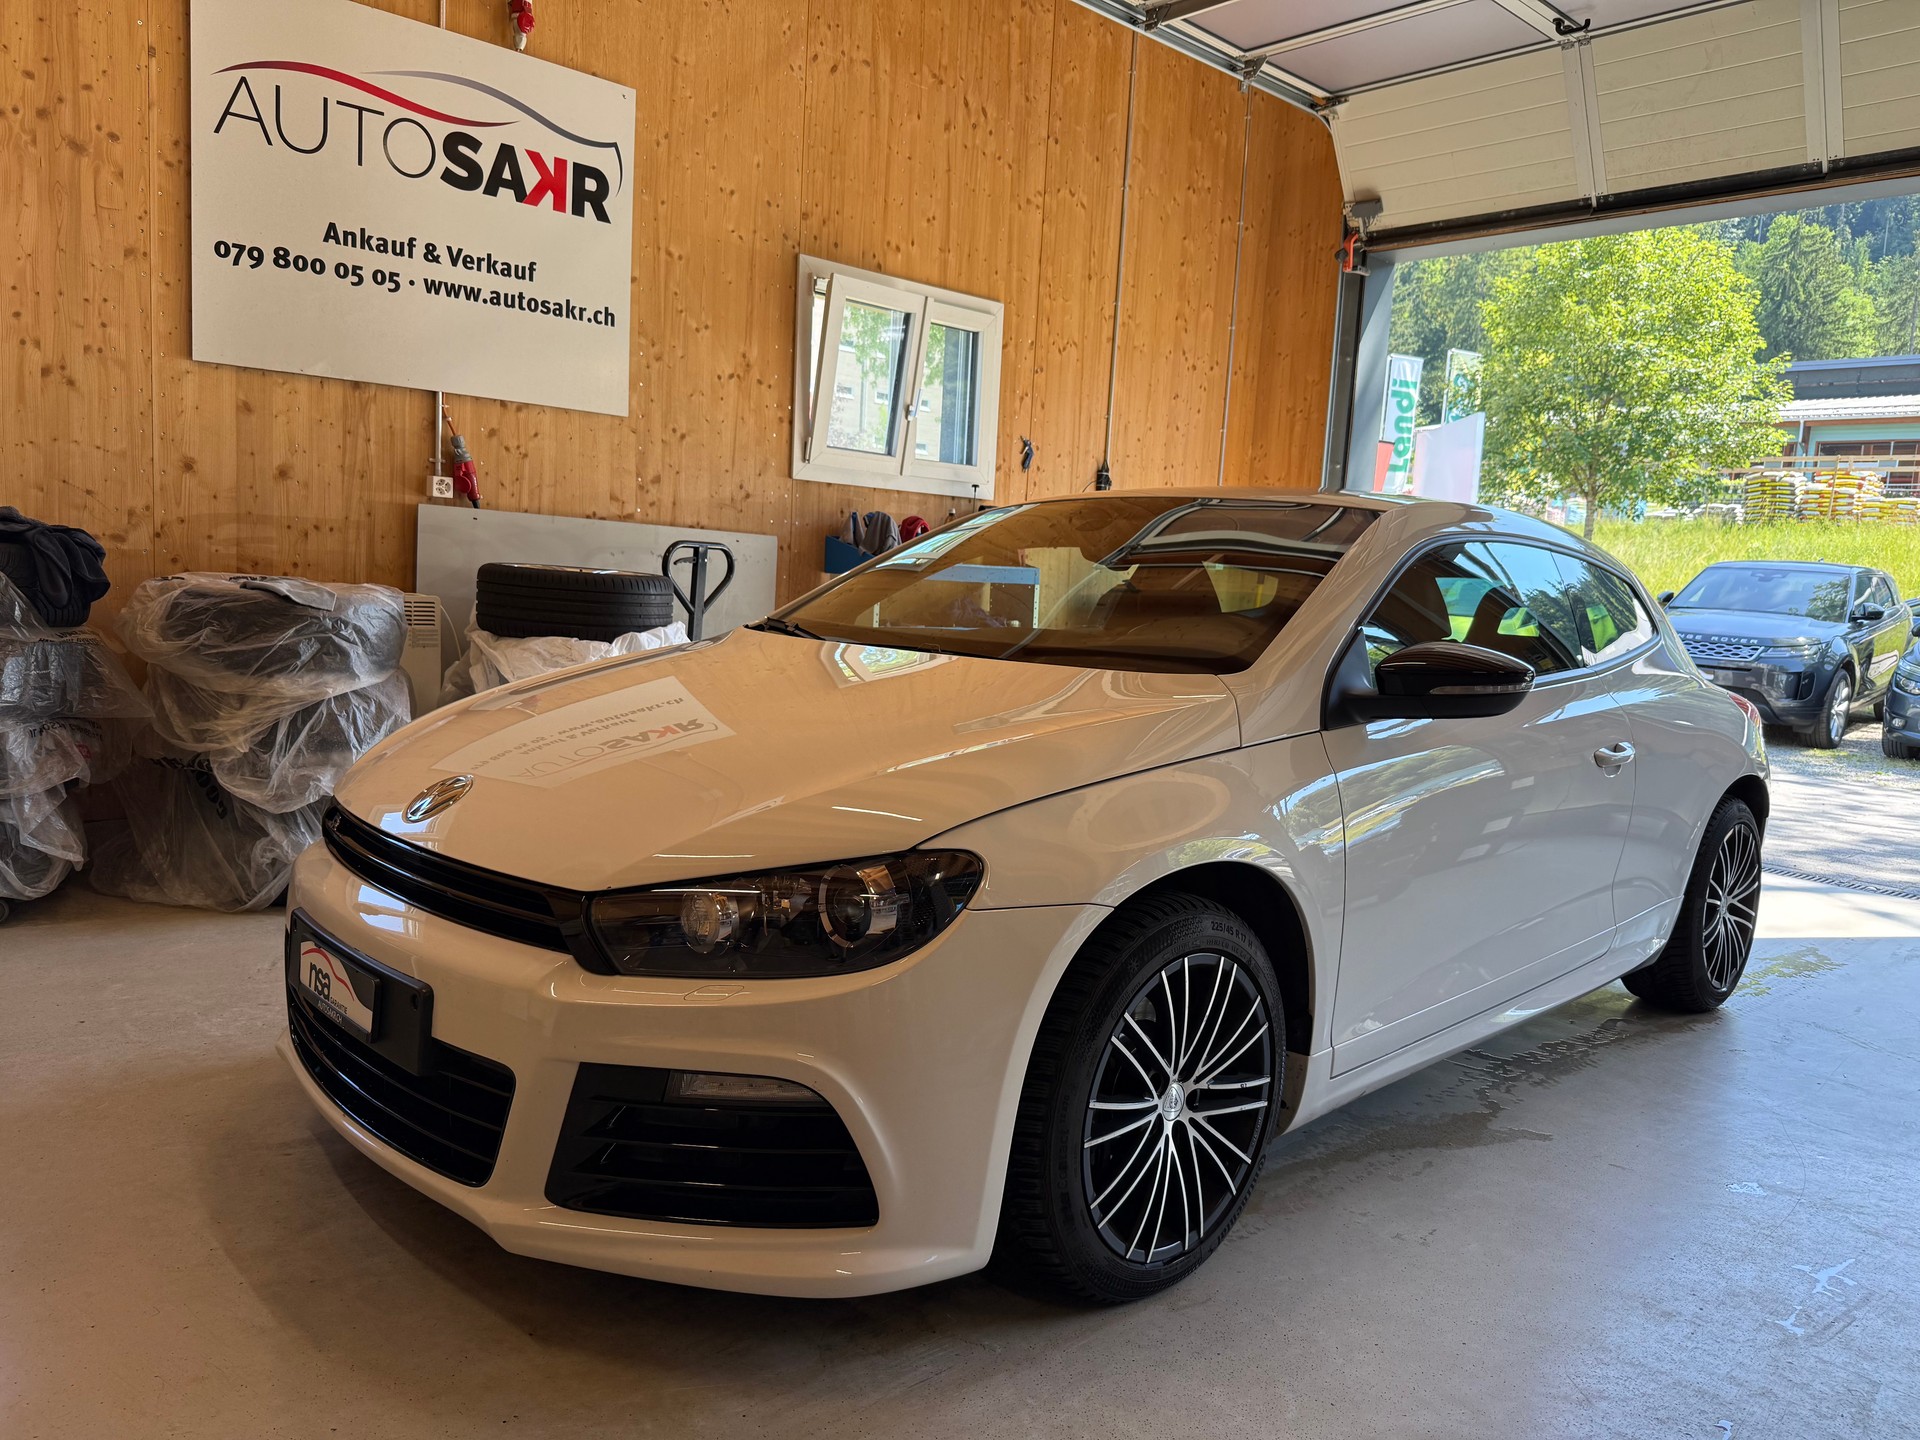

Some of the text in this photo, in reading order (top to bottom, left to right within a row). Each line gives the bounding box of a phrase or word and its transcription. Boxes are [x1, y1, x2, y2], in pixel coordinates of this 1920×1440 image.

[323, 221, 537, 282] Ankauf & Verkauf
[213, 239, 265, 270] 079
[272, 246, 326, 277] 800
[334, 260, 364, 287] 05
[372, 267, 401, 293] 05
[423, 277, 616, 328] www.autosakr.ch
[1388, 378, 1419, 473] Landi
[1711, 635, 1759, 644] ROVER
[1211, 921, 1234, 936] 225/45
[309, 962, 331, 1001] nsa
[330, 996, 348, 1014] GARANTIE
